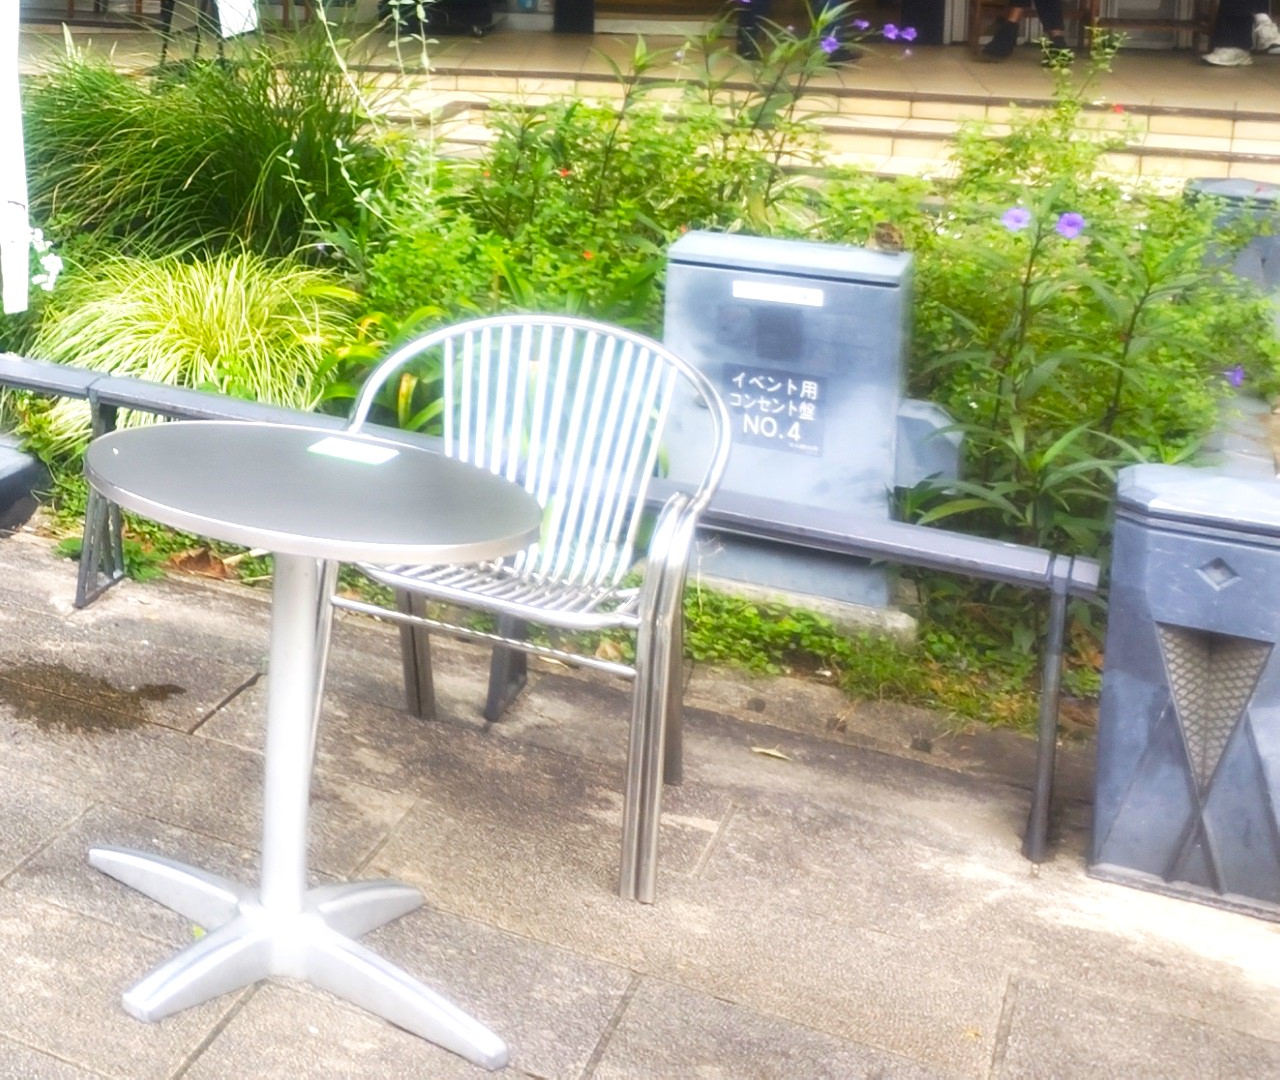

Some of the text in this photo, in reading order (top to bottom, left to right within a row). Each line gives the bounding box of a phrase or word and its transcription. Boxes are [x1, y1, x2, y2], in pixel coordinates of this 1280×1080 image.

[731, 372, 818, 400] イベント用
[729, 392, 816, 421] コンセント盤
[743, 413, 801, 441] NO.4
